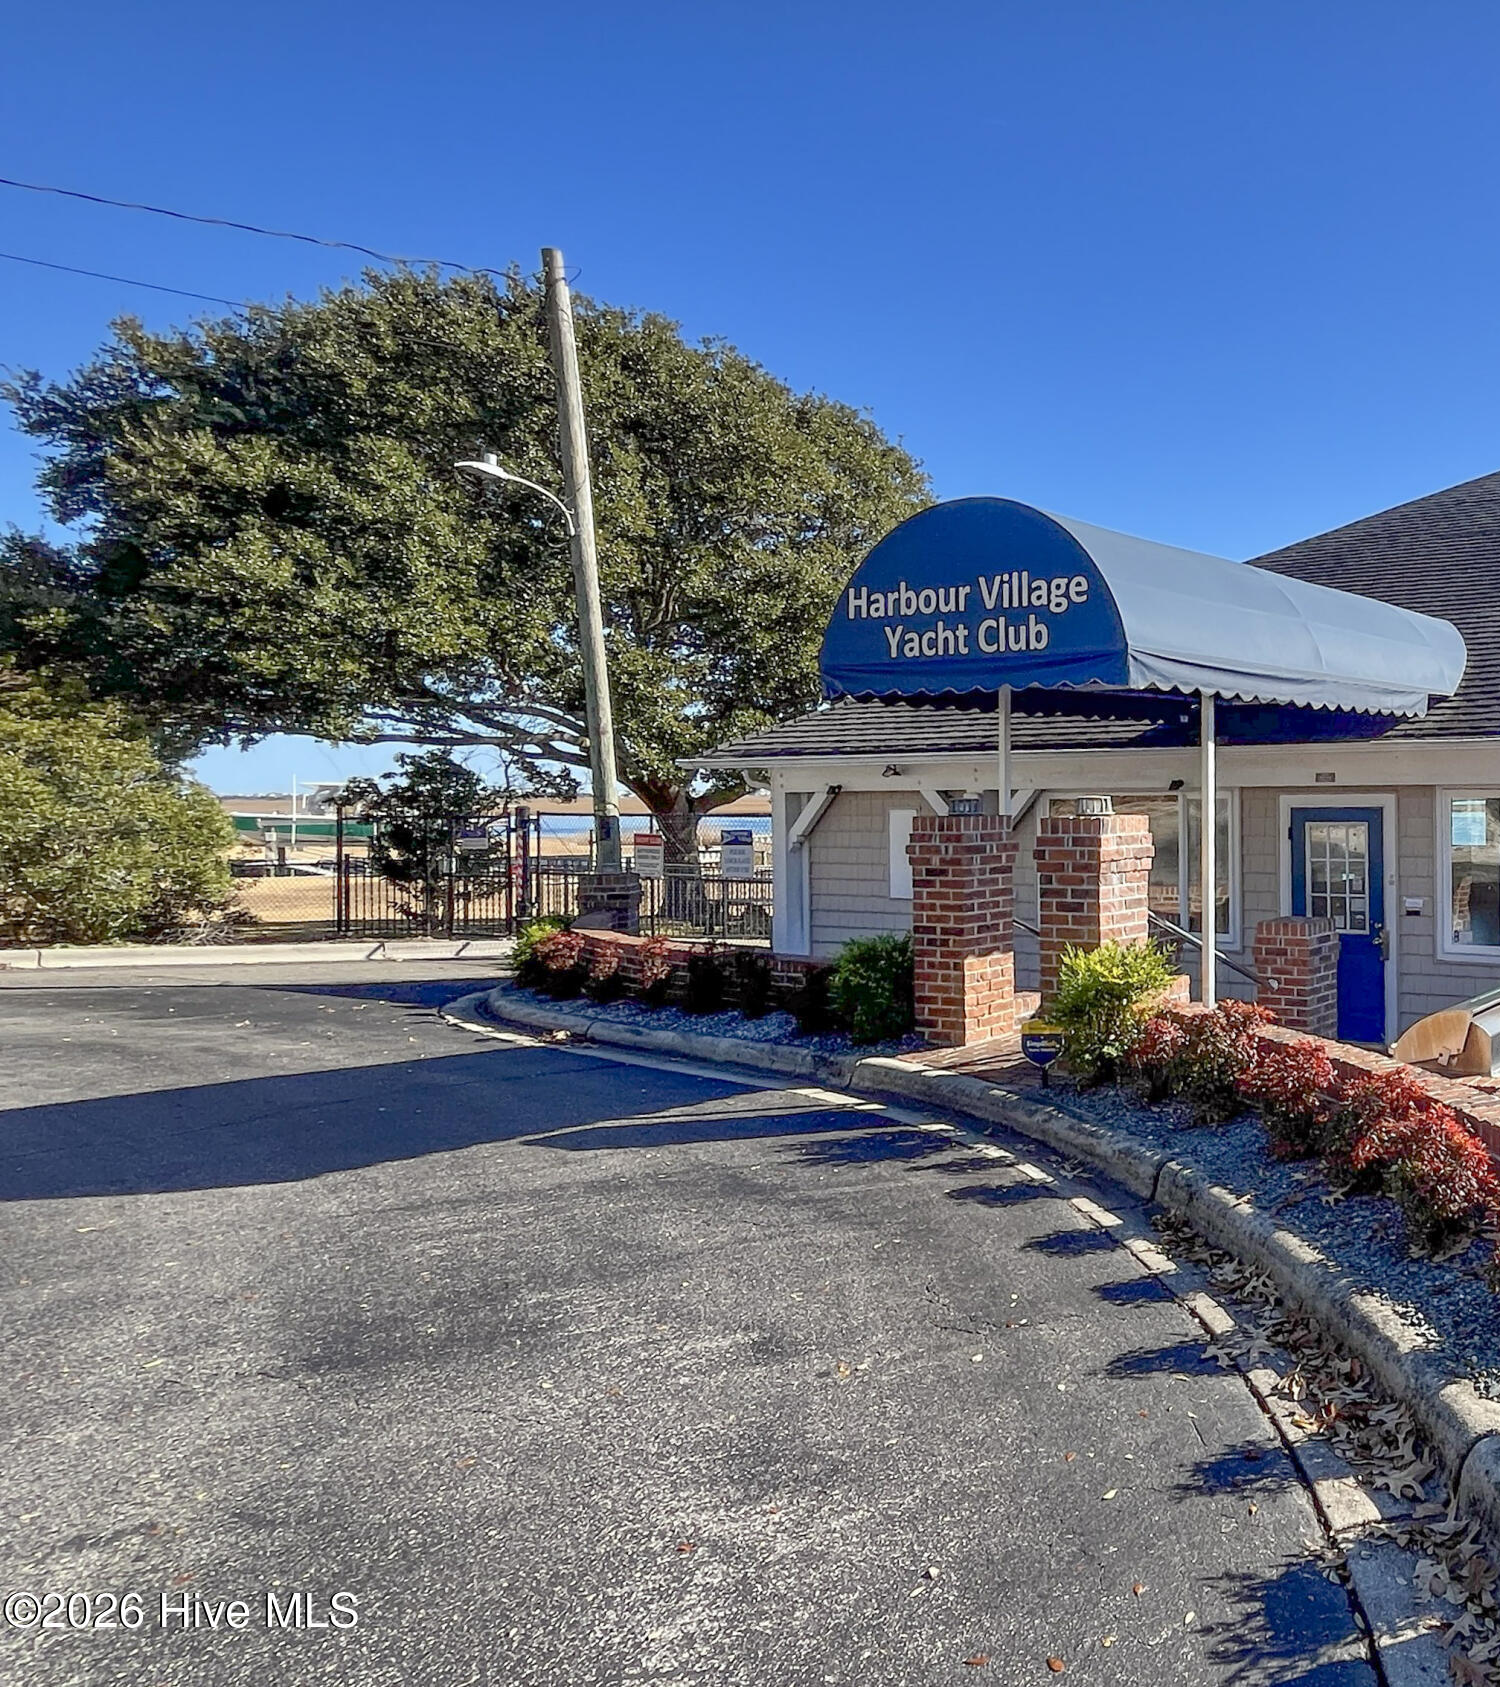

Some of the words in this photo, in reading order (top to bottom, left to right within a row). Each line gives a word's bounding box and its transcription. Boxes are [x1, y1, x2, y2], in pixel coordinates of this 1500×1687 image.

[848, 581, 970, 619] Harbour
[978, 570, 1089, 613] Village
[884, 621, 969, 658] Yacht
[978, 614, 1048, 653] Club
